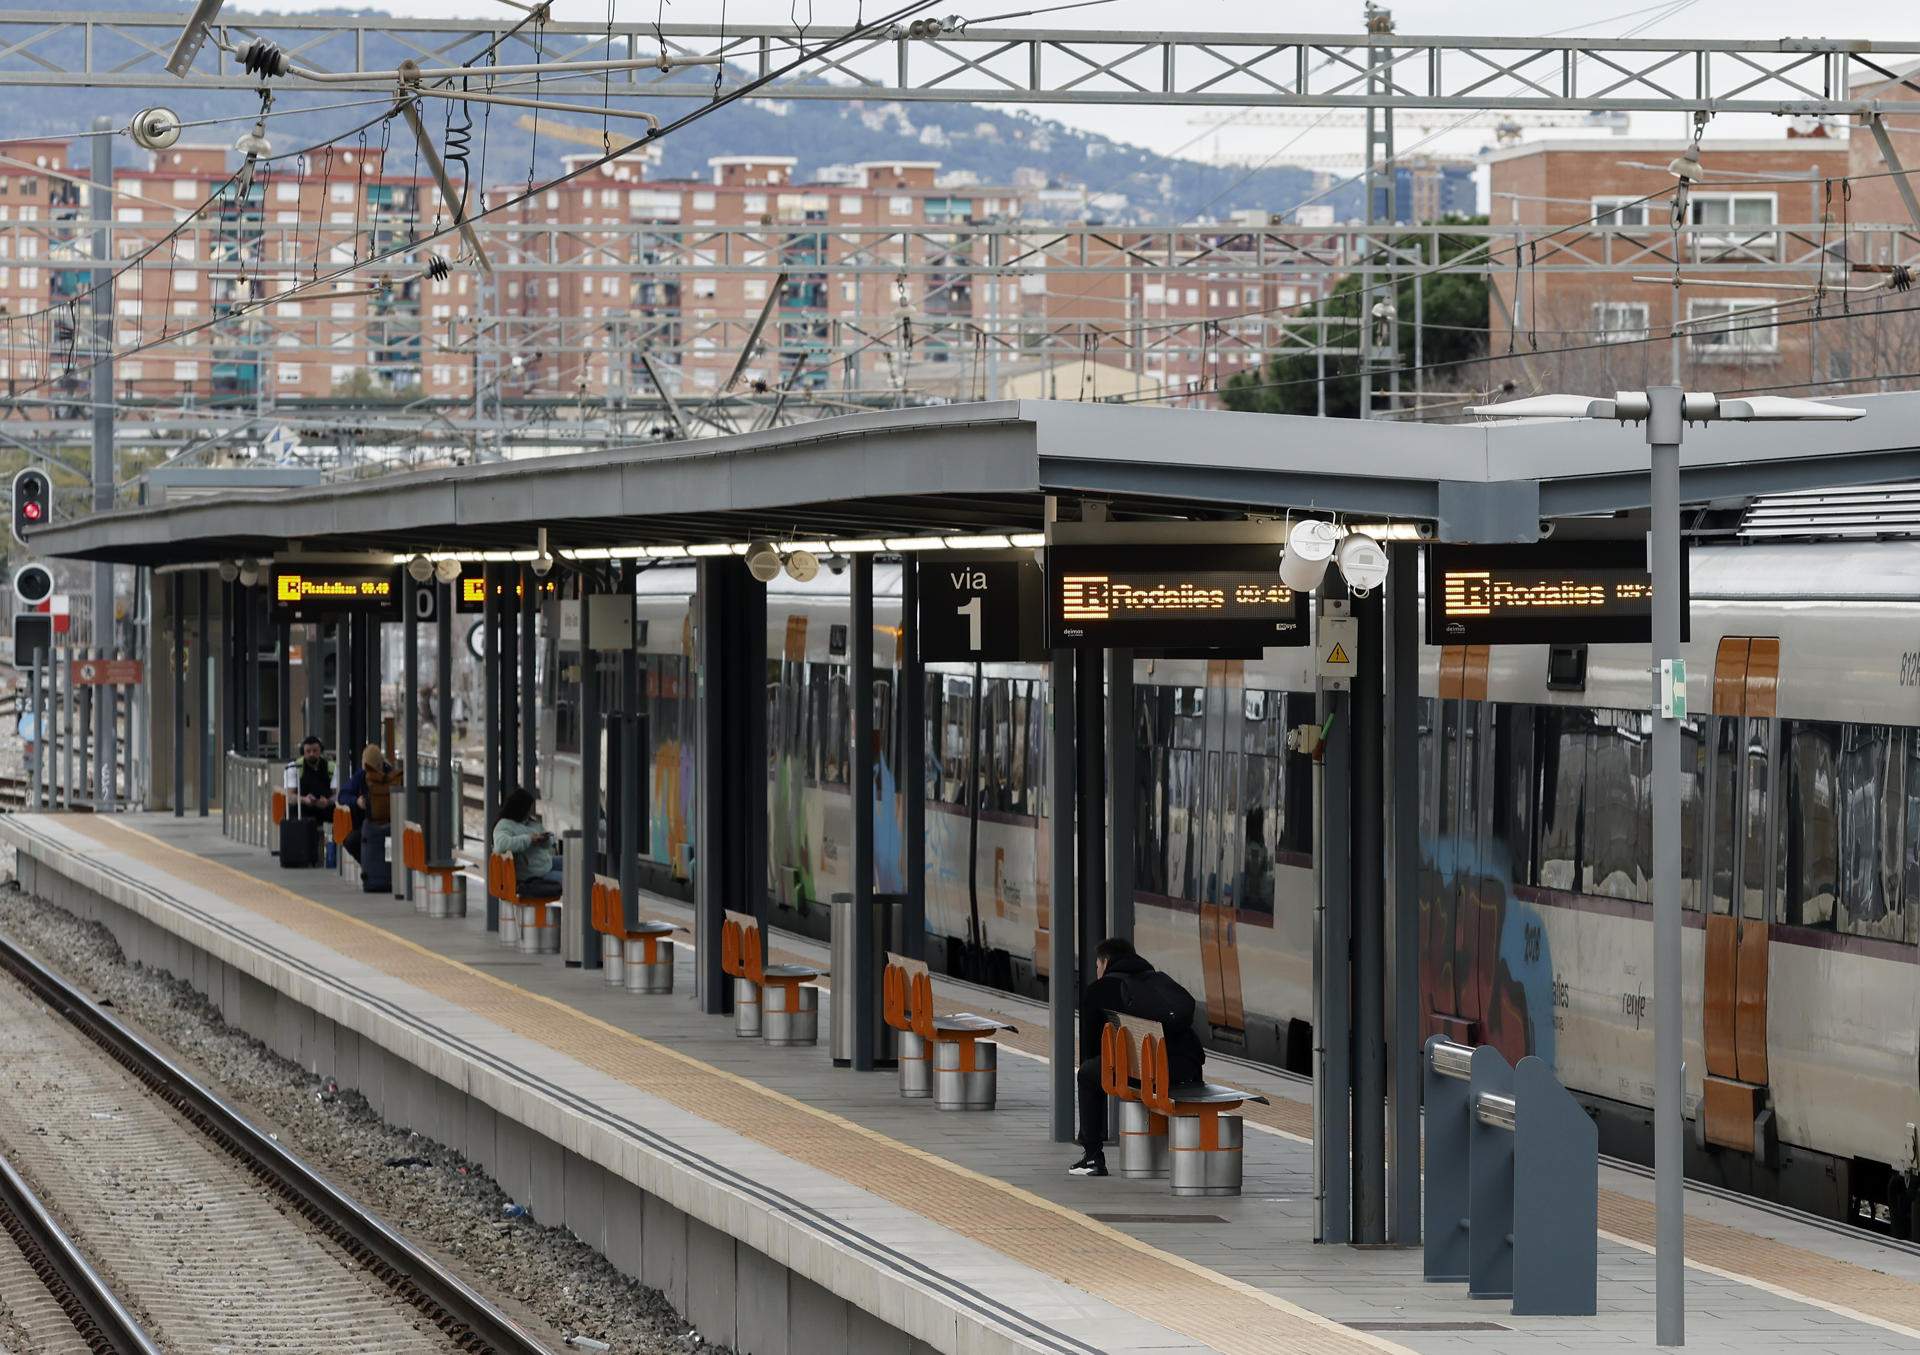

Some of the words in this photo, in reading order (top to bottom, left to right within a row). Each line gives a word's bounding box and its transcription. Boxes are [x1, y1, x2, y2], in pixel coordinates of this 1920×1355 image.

[950, 566, 988, 590] via
[1112, 584, 1225, 609] Rodalies
[1493, 581, 1605, 605] Rodalies
[957, 597, 982, 651] 1
[1622, 981, 1646, 1031] renfe
